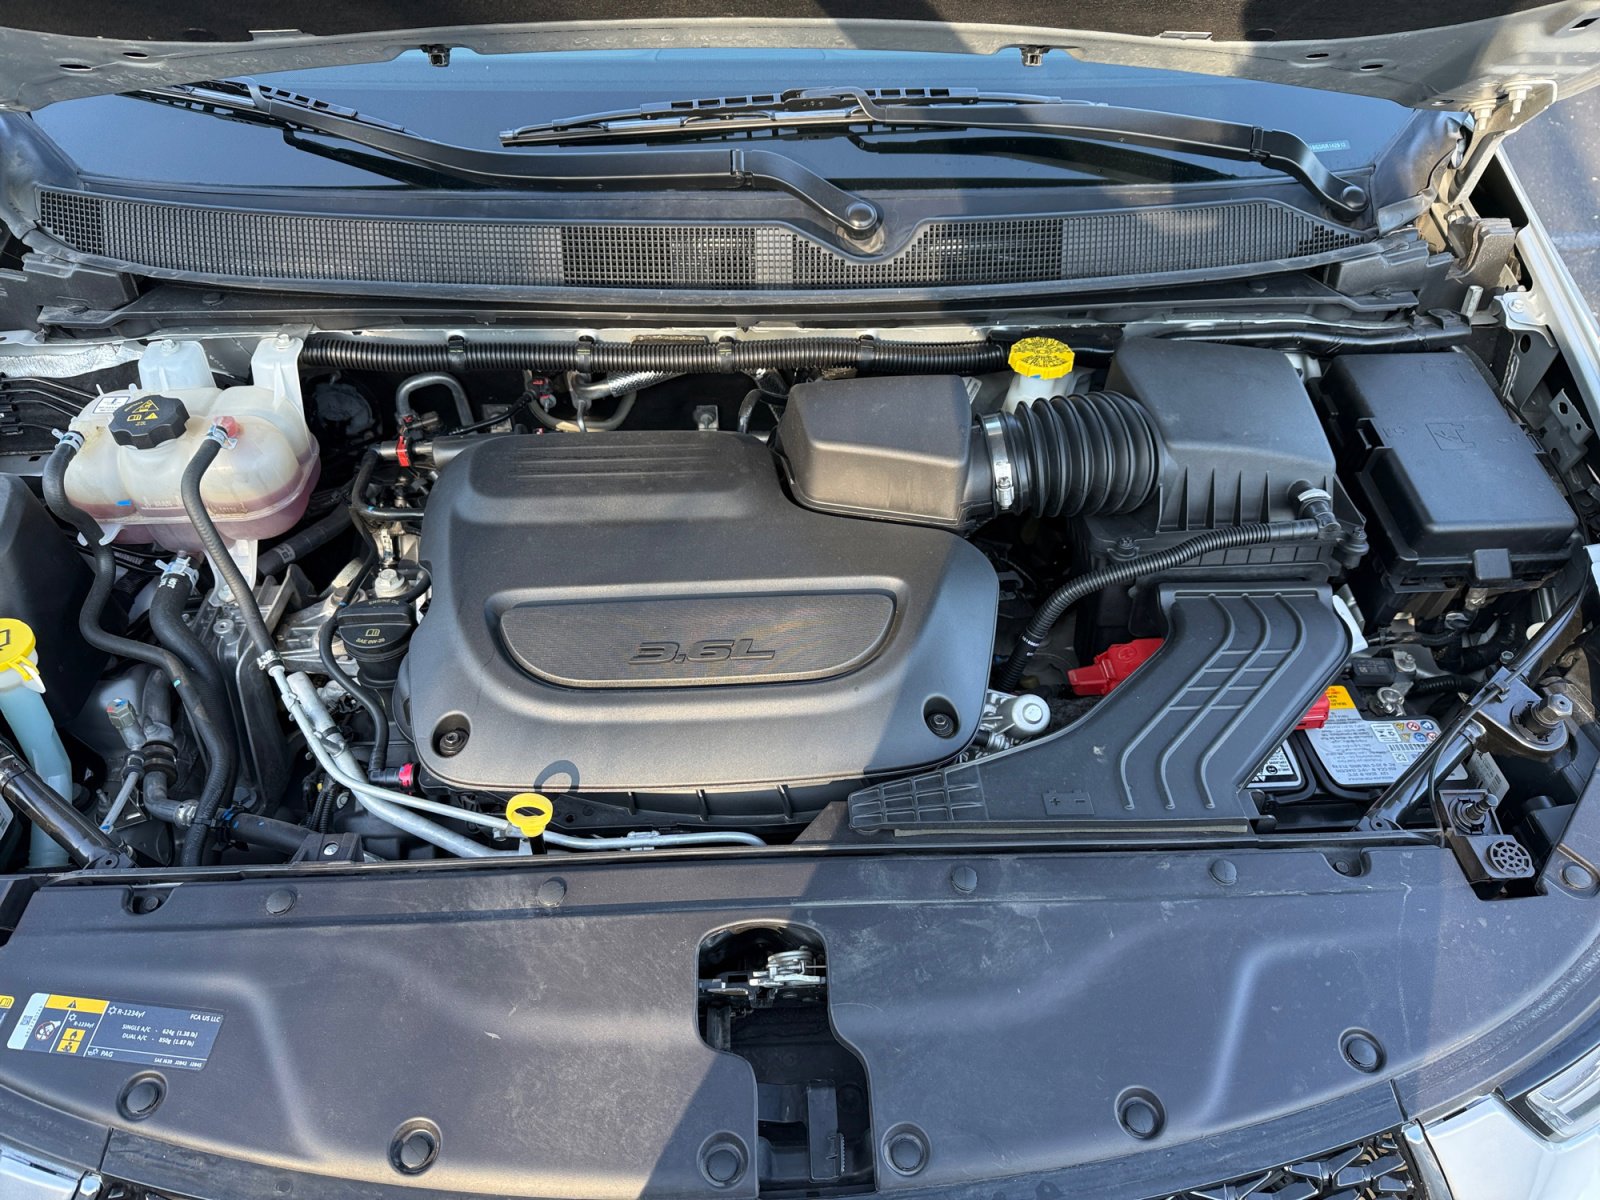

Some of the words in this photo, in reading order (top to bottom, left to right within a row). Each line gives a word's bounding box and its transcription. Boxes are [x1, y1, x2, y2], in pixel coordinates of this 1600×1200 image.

[628, 638, 775, 665] 3.6L
[117, 1008, 146, 1019] R-1234yf
[189, 1013, 201, 1021] FCA
[210, 1015, 221, 1023] LLC
[121, 1023, 140, 1032] SINGLE
[140, 1025, 152, 1033] A/C
[121, 1032, 137, 1040] DUAL
[136, 1033, 148, 1041] A/C
[100, 1049, 114, 1058] PAG
